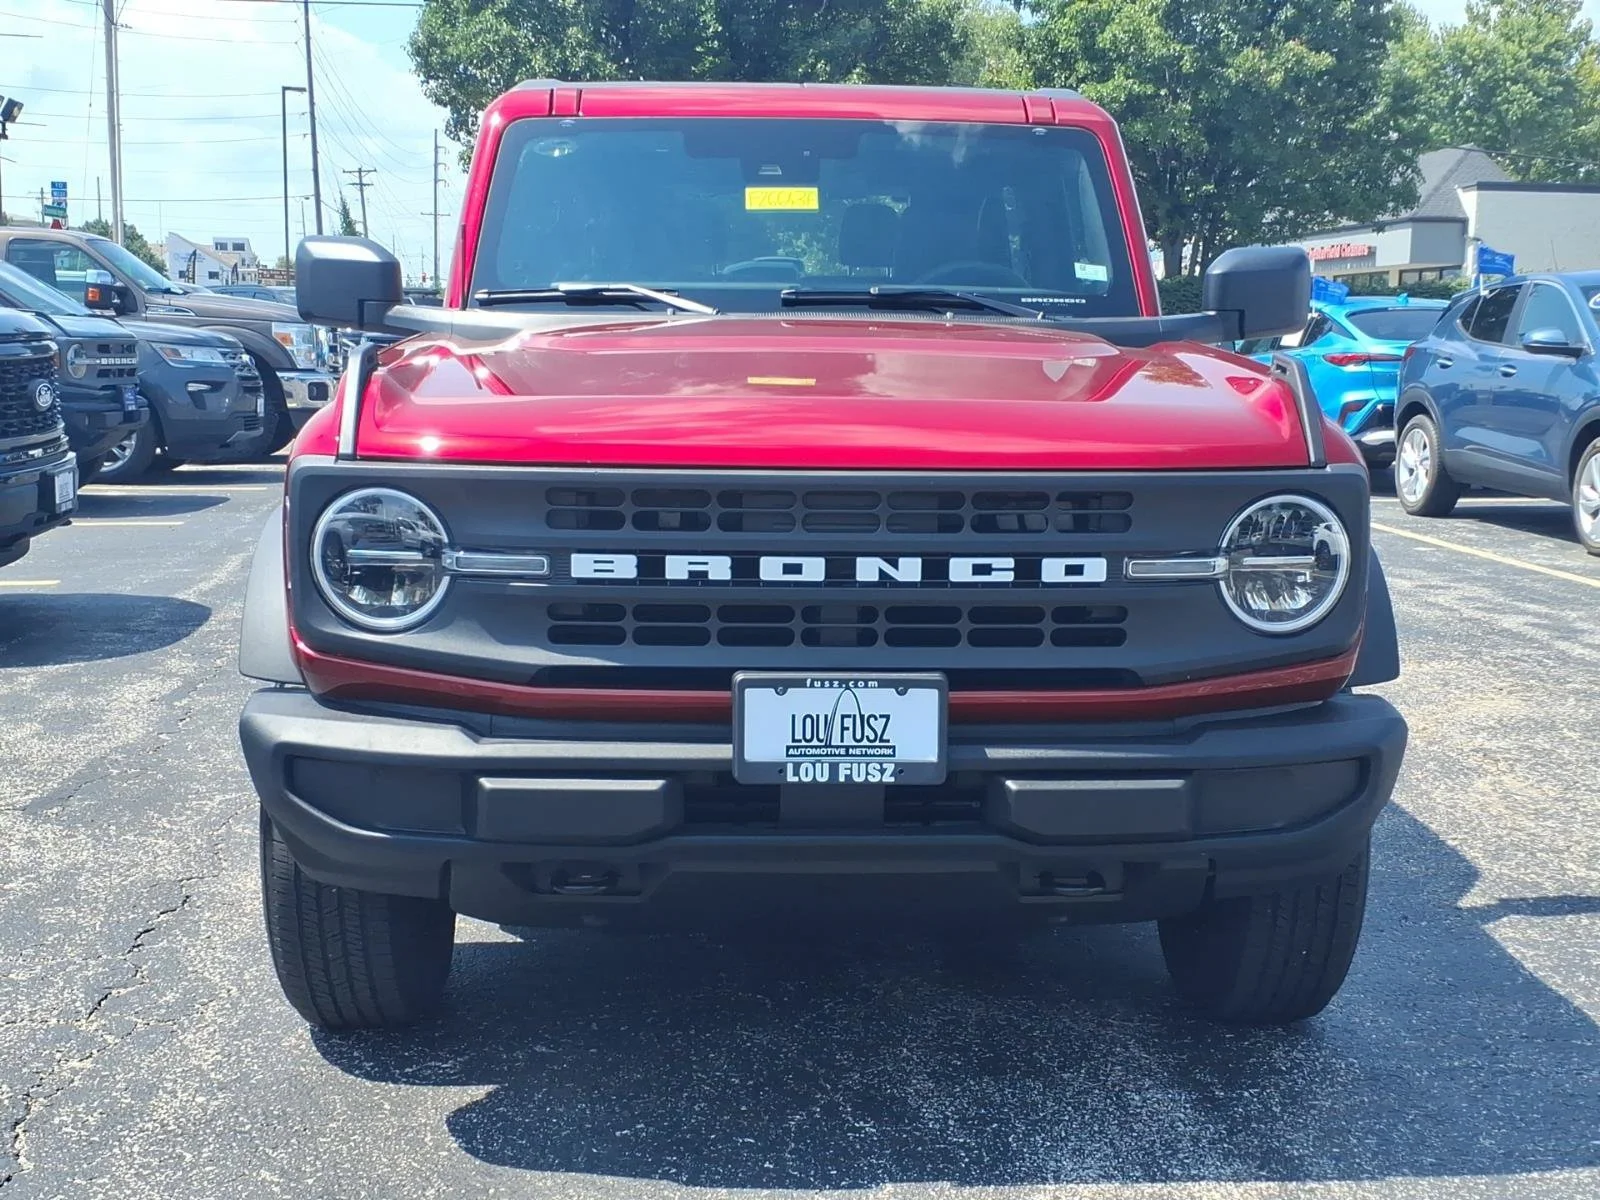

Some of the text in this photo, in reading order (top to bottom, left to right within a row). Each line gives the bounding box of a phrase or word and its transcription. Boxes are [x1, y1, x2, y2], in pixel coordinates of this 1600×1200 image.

[571, 553, 1107, 582] BRONCO
[806, 678, 878, 688] fusz.com
[791, 714, 891, 743] LOU FUSZ
[787, 763, 895, 782] LOU FUSZ
